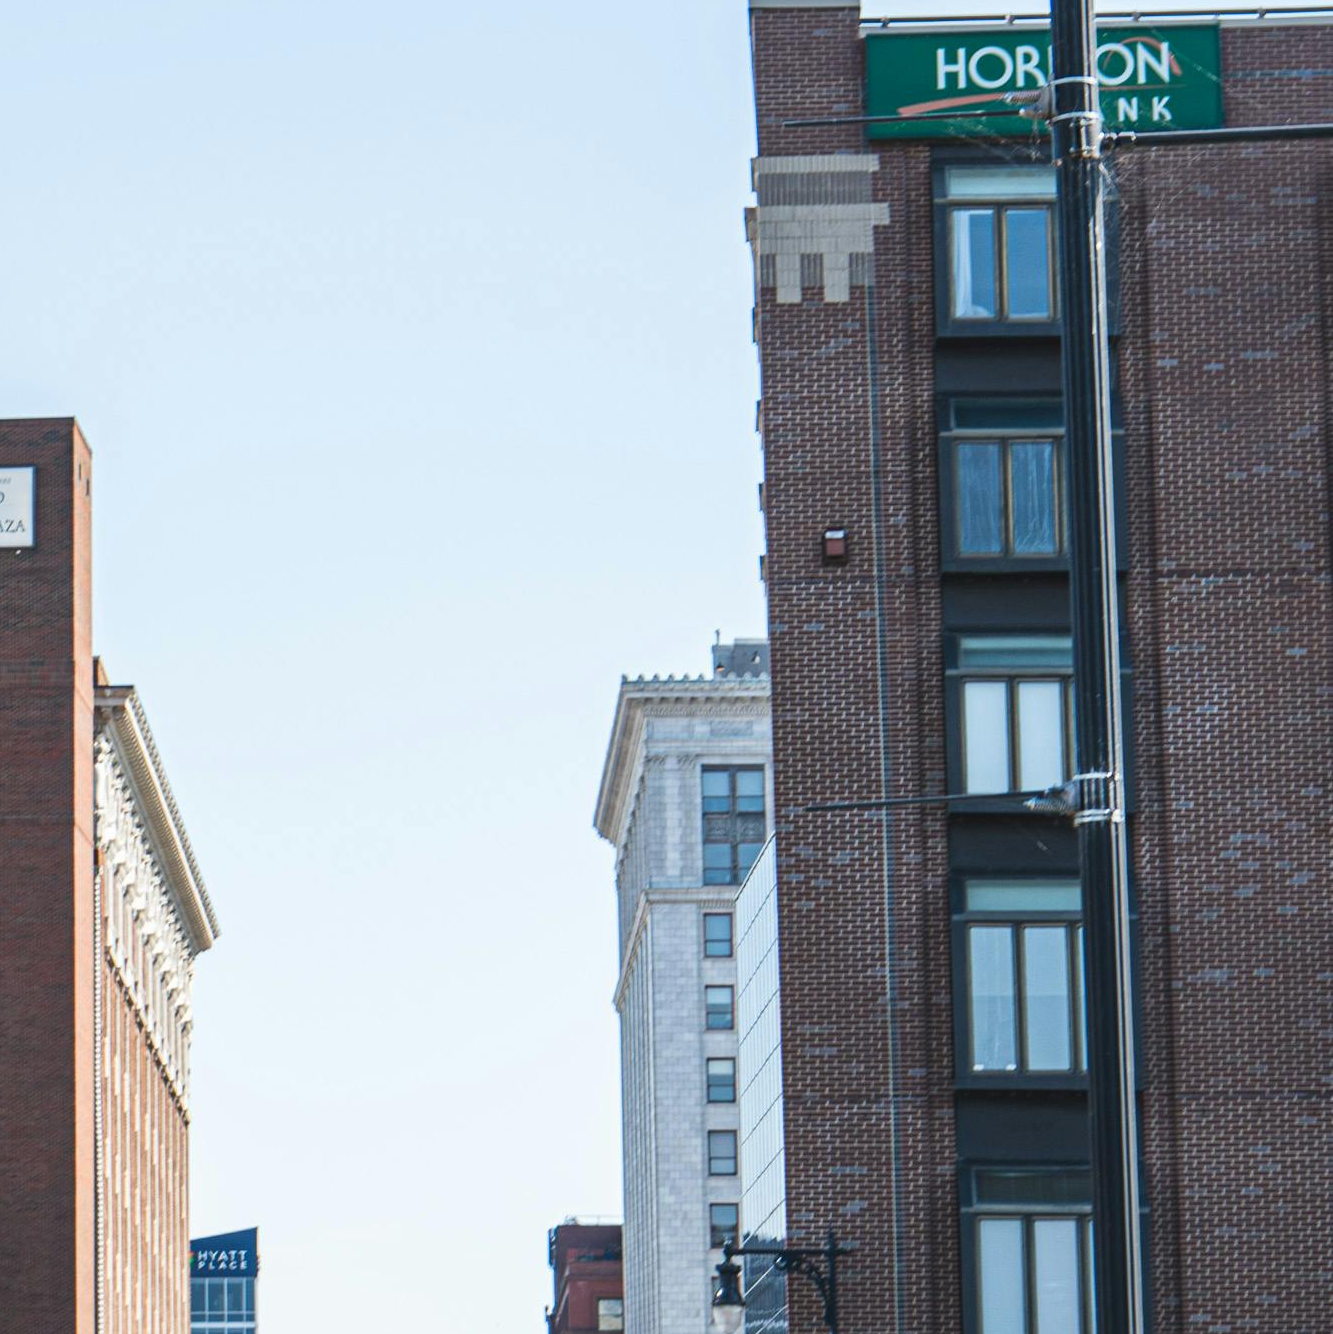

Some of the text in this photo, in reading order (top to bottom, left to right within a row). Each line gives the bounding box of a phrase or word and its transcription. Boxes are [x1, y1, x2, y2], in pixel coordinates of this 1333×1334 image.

[936, 41, 1170, 89] HORION
[197, 1250, 248, 1263] HYATT
[197, 1260, 248, 1271] PLACE
